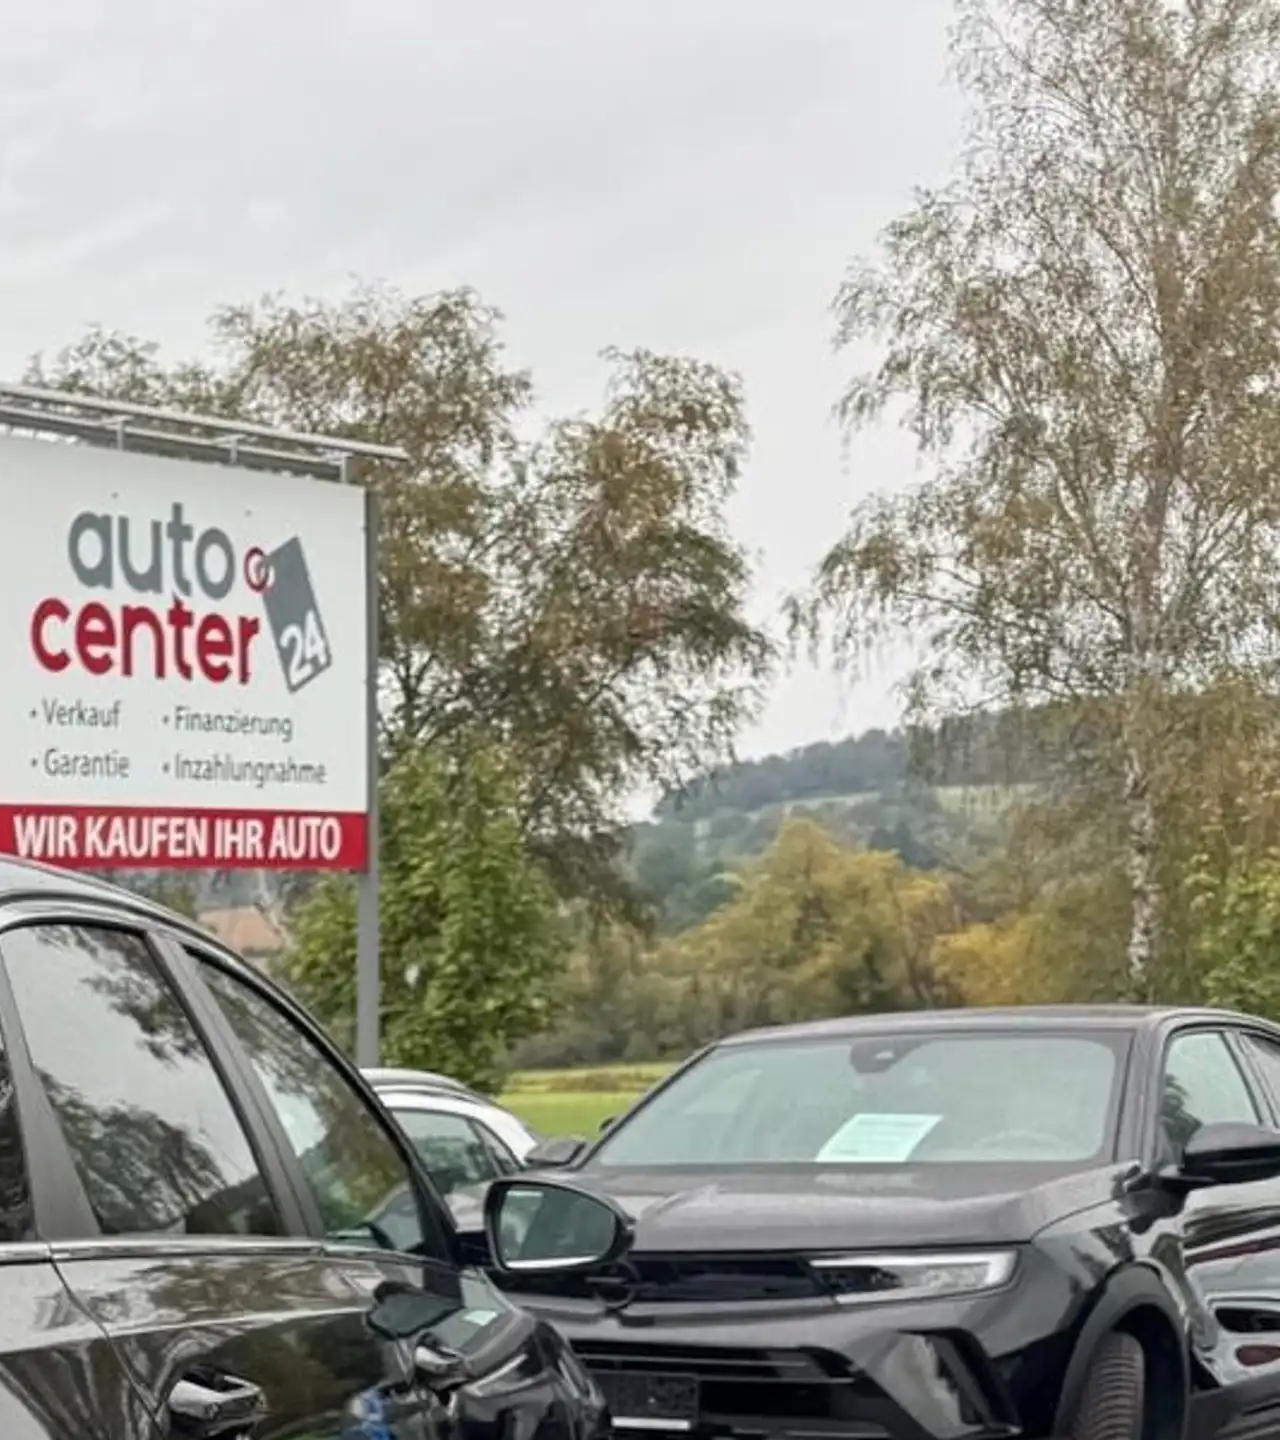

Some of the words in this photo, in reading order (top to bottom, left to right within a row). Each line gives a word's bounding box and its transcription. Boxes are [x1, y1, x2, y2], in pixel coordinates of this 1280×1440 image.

[68, 502, 236, 599] auto
[31, 597, 260, 685] center
[279, 610, 327, 686] 24
[41, 698, 121, 728] Verkauf
[175, 704, 293, 743] Finanzierung
[43, 748, 130, 778] Garantie
[175, 752, 328, 788] Inzahlungnahme
[13, 815, 77, 857] WIR
[85, 815, 206, 858] KAUFEN
[214, 818, 264, 858] IHR
[268, 816, 342, 860] AUTO
